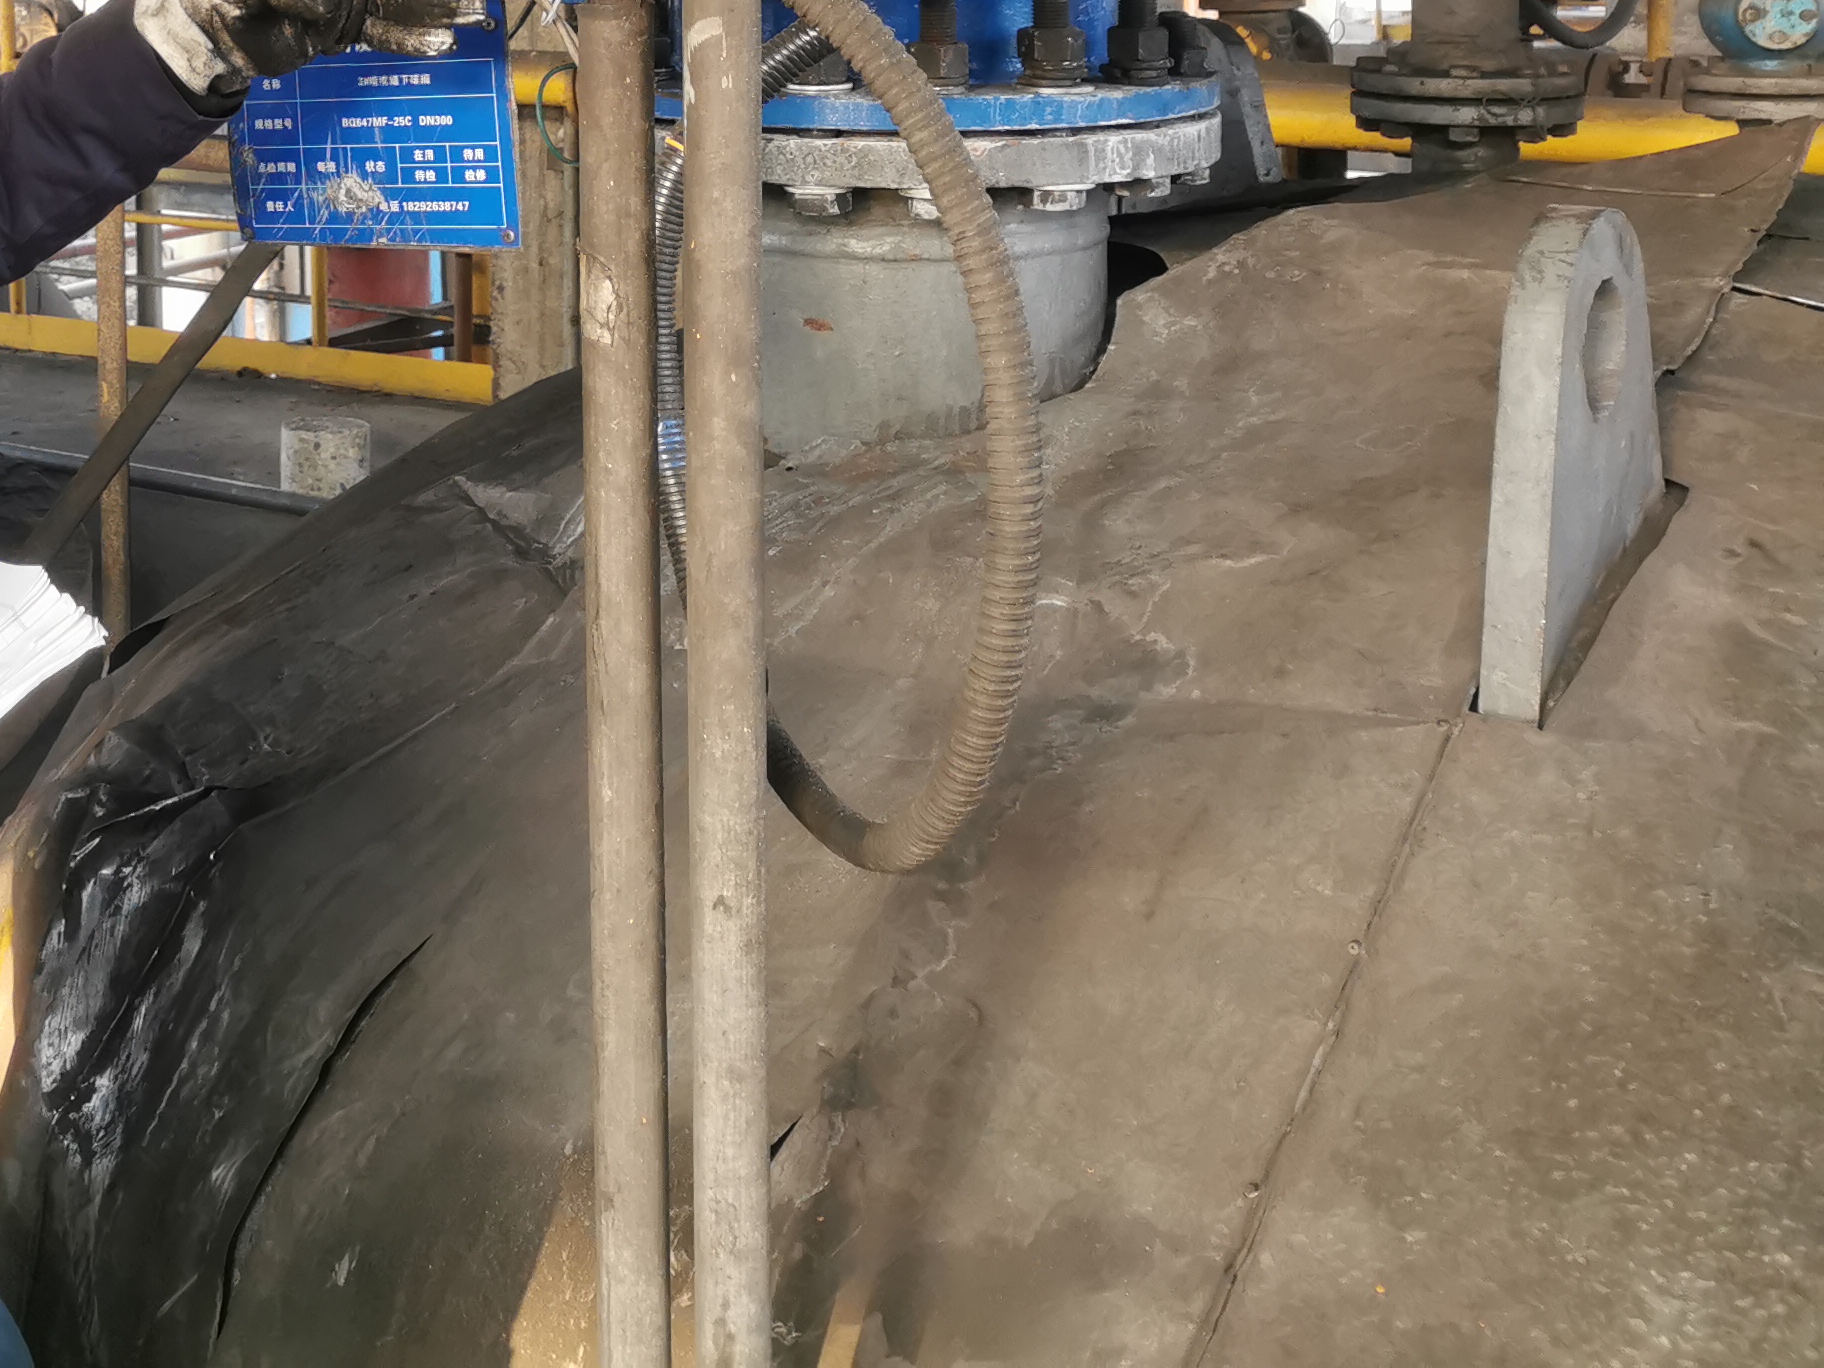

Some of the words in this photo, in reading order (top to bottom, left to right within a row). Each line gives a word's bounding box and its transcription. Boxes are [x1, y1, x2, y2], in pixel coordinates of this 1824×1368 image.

[262, 78, 281, 90] 名称
[255, 118, 292, 129] 规格型号
[419, 115, 453, 126] DN300
[413, 149, 434, 161] 在用
[463, 148, 484, 160] 待用
[365, 160, 385, 172] 状态
[415, 170, 436, 181] 待检
[465, 169, 487, 181] 检修
[266, 201, 294, 212] 责任人
[402, 201, 469, 211] 18292638747
